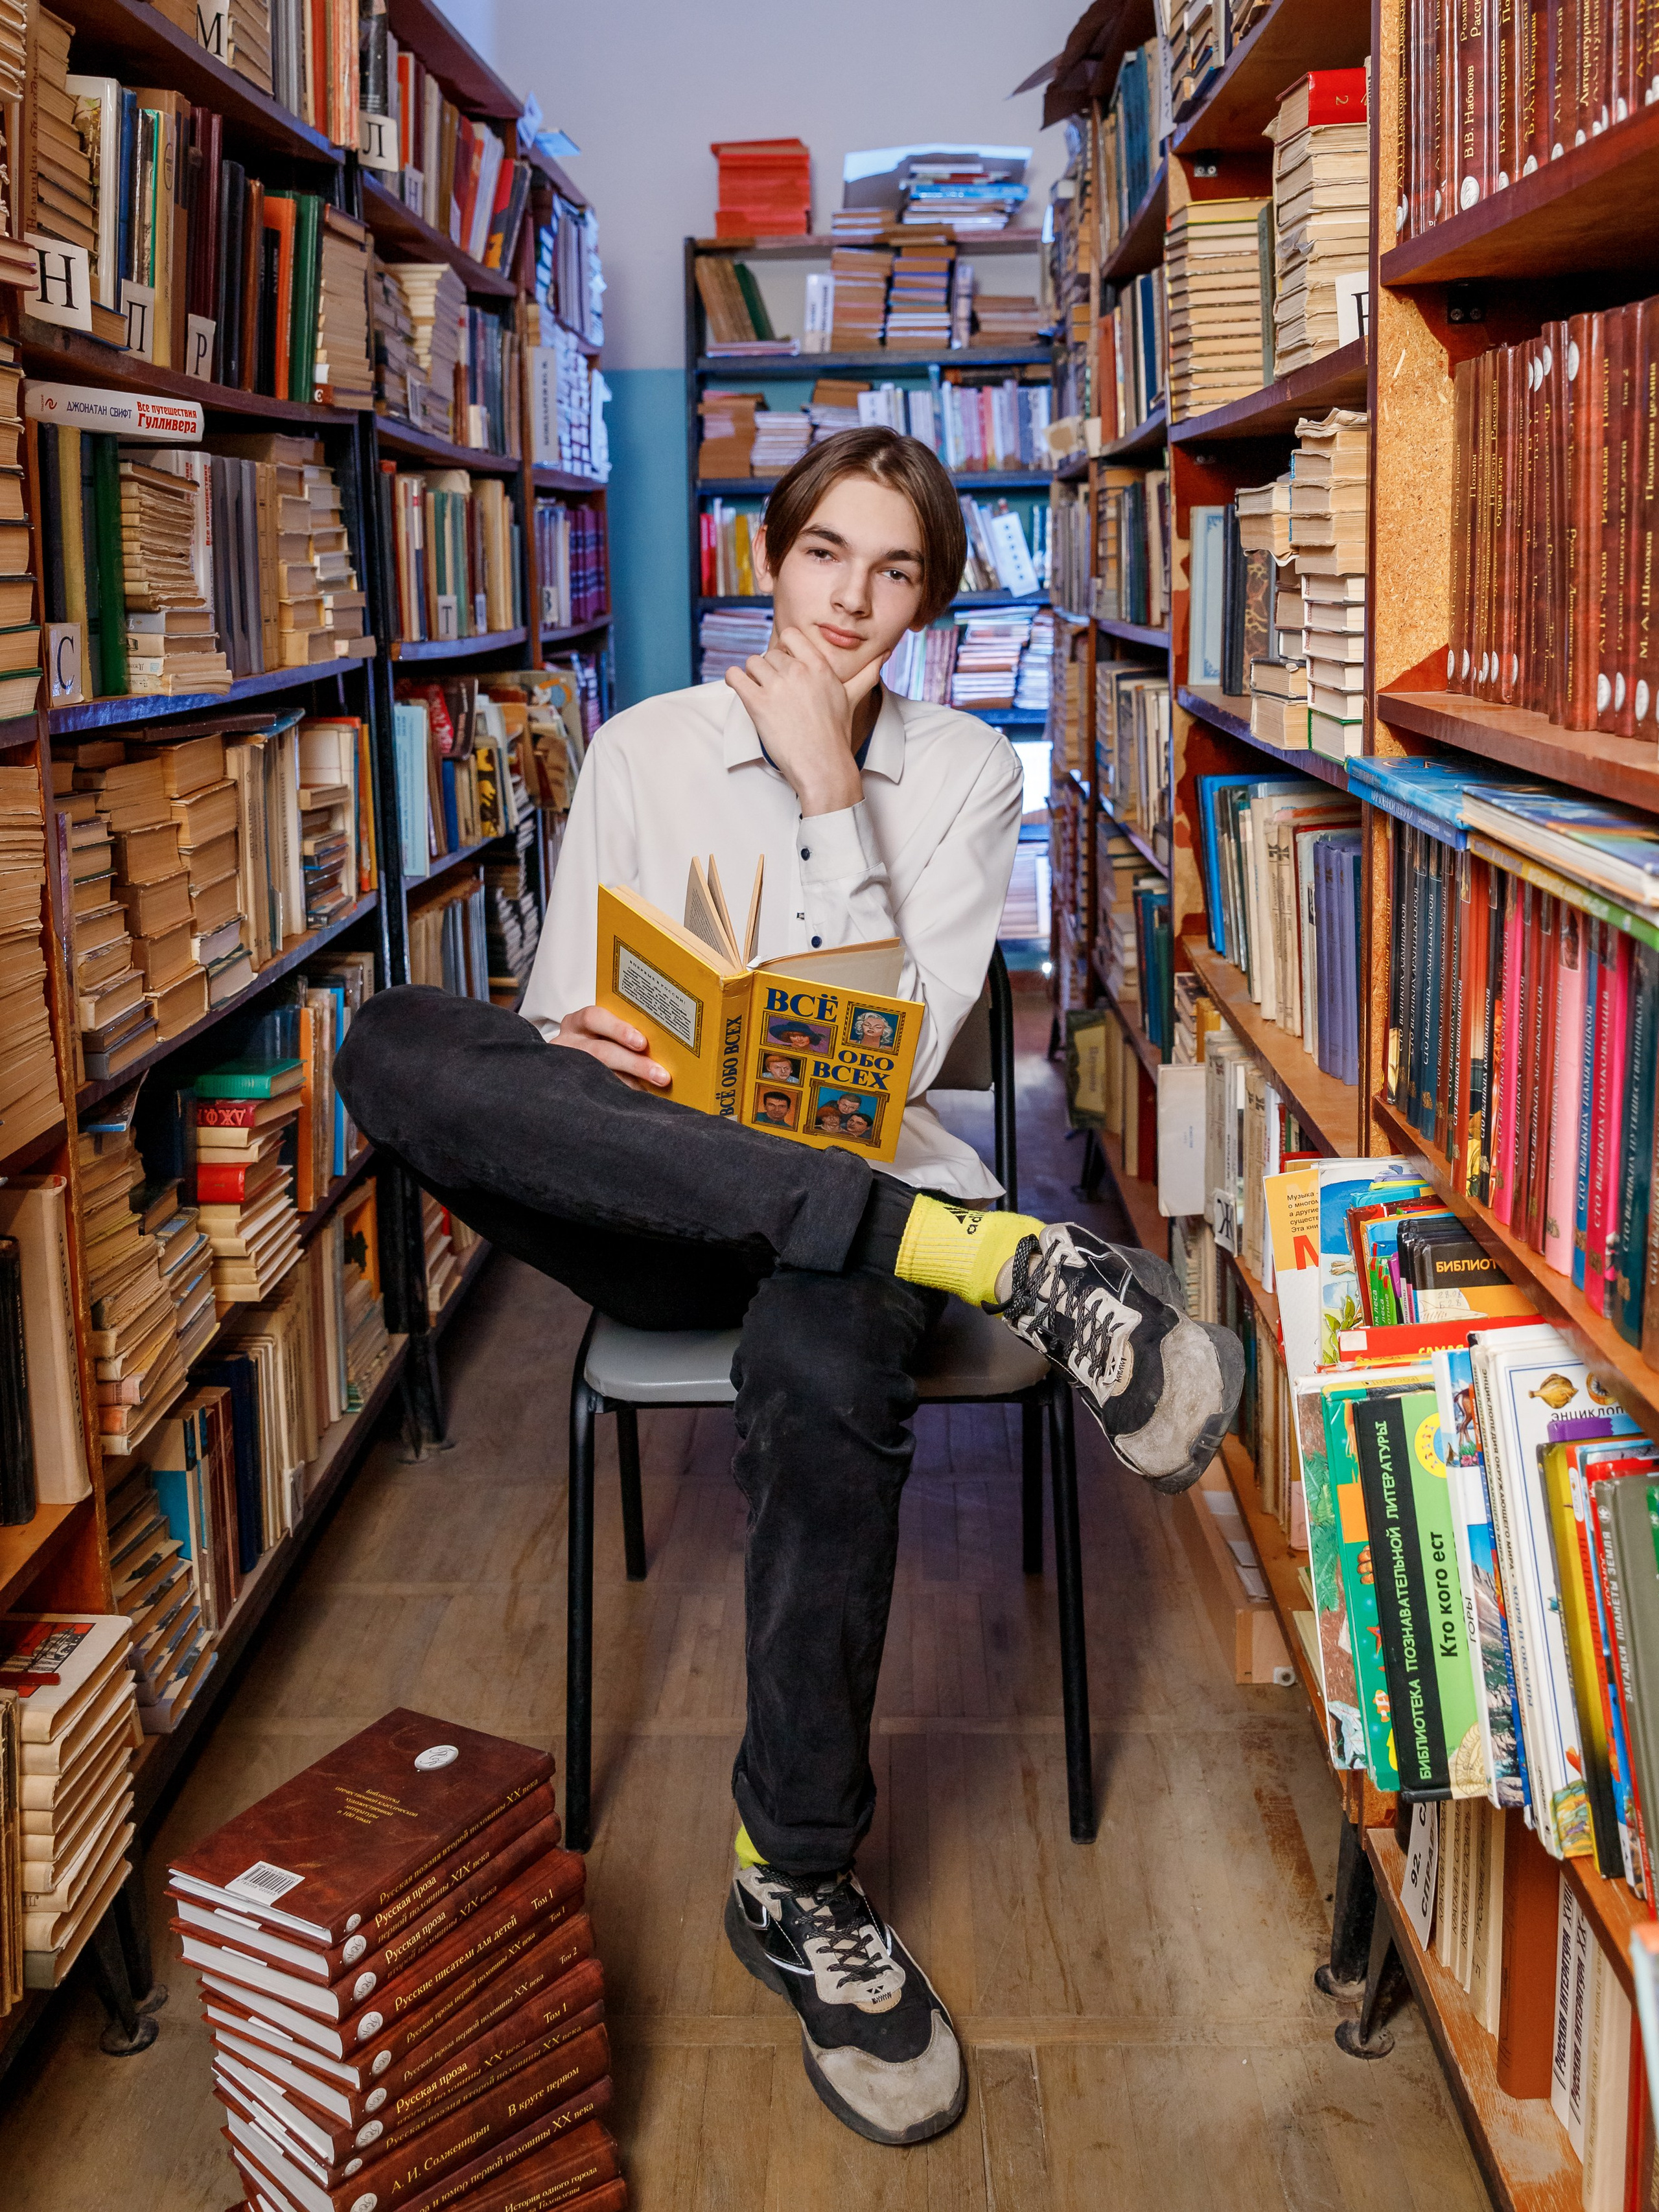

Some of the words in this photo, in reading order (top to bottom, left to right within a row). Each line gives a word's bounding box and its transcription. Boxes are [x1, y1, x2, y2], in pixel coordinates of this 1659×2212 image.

[196, 12, 224, 57] М
[1529, 12, 1538, 91] Пастернак
[1336, 95, 1349, 106] 2
[1464, 65, 1474, 125] Набоков
[1498, 40, 1507, 113] Некрасов
[364, 121, 385, 158] Л
[1464, 128, 1474, 159] В.В.
[29, 248, 79, 310] Н
[126, 301, 146, 352] П
[196, 332, 207, 375] Р
[67, 401, 108, 416] ДЖОНАТАН
[110, 408, 132, 419] СВИФТ
[137, 402, 150, 413] Все
[152, 406, 197, 419] путешествия
[1649, 363, 1658, 418] целина
[137, 413, 197, 433] Гулливера
[1645, 422, 1654, 500] Поднятая
[442, 606, 453, 635] Т
[56, 636, 75, 690] С
[1426, 894, 1434, 986] АРХИТЕКТОРОВ
[765, 987, 839, 1022] ВСЁ
[725, 1015, 743, 1055] ВСЕХ
[839, 1049, 894, 1071] ОБО
[1581, 1005, 1594, 1106] ПАМЯТНИКОВ
[1597, 991, 1610, 1113] ПОЛКОВОДЦЕВ
[721, 1056, 738, 1086] ОБО
[811, 1060, 890, 1090] ВСЕХ
[716, 1089, 736, 1116] ВСЁ
[1578, 1113, 1590, 1177] ВЕЛИКИХ
[1595, 1118, 1606, 1192] ВЕЛИКИХ
[1287, 1191, 1314, 1201] Музыка
[1577, 1181, 1586, 1211] СТО
[1593, 1195, 1603, 1228] СТО
[1623, 1157, 1636, 1220] ВЕЛИКИХ
[1217, 1198, 1233, 1239] Ж
[1621, 1222, 1631, 1252] СТО
[1373, 1421, 1400, 1520] ЛИТЕРАТУРЫ
[1472, 1364, 1489, 1449] ЭНЦИКЛОПЕДИЯ
[1496, 1534, 1505, 1563] МИРА
[1481, 1368, 1499, 1454] ЭНЦИКЛОПЕДИЯ
[1494, 1456, 1511, 1538] ОКРУЖАЮЩЕГО
[1505, 1540, 1515, 1571] МИРА
[1429, 1531, 1446, 1563] ест
[1601, 1531, 1617, 1576] ЗЕМЛЯ
[1385, 1527, 1419, 1672] ПОЗНАВАТЕЛЬНОЙ
[1432, 1567, 1452, 1616] кого
[1512, 1584, 1523, 1624] МОРЯ
[1608, 1580, 1627, 1641] ПЛАНЕТЫ
[1438, 1621, 1459, 1658] Кто
[1464, 1596, 1477, 1644] ГОРЫ
[1517, 1629, 1527, 1641] И
[1520, 1645, 1535, 1708] ОКЕАНЫ
[1617, 1644, 1634, 1702] ЗАГАДКИ
[1406, 1679, 1432, 1780] БИБЛИОТЕКА
[335, 1786, 377, 1804] отечественной
[377, 1799, 418, 1817] классической
[344, 1804, 380, 1820] литературы
[345, 1797, 393, 1816] художественной
[365, 1789, 400, 1804] Библиотека
[380, 1876, 413, 1905] Русская
[415, 1852, 441, 1878] поэзия
[443, 1829, 469, 1856] второй
[470, 1803, 506, 1836] половины
[506, 1788, 522, 1806] XX
[522, 1779, 539, 1794] века
[1462, 1814, 1472, 1878] СЛОВАРЬ
[1411, 1852, 1422, 1889] 92.
[375, 1896, 412, 1928] Русская
[412, 1876, 437, 1900] проза
[378, 1913, 408, 1943] первой
[409, 1883, 449, 1919] половины
[451, 1861, 470, 1885] XIX
[472, 1851, 490, 1869] века
[385, 1932, 421, 1964] Русская
[422, 1911, 447, 1935] проза
[395, 1978, 434, 2011] Русские
[435, 1948, 475, 1983] писатели
[476, 1937, 493, 1953] для
[494, 1914, 517, 1941] детей
[531, 1896, 548, 1910] Том
[548, 1888, 554, 1899] 1
[1558, 1927, 1572, 2009] ЛИТЕРАТУРА
[404, 2056, 434, 2081] Русская
[434, 2039, 454, 2059] проза
[456, 2018, 480, 2042] первой
[480, 1996, 513, 2023] половины
[515, 1981, 529, 1999] XX
[529, 1973, 544, 1988] века
[559, 1954, 572, 1965] Том
[572, 1946, 578, 1955] 2
[386, 2122, 426, 2149] Русская
[428, 2099, 461, 2124] поэзия
[463, 2076, 495, 2101] второй
[497, 2050, 542, 2080] половины
[542, 2034, 561, 2053] XX
[562, 2025, 581, 2041] века
[395, 2080, 438, 2114] Русская
[439, 2062, 468, 2086] проза
[508, 2104, 517, 2117] В
[518, 2090, 544, 2112] круге
[546, 2067, 579, 2092] первом
[391, 2180, 404, 2193] А.
[407, 2168, 421, 2183] И.
[424, 2123, 491, 2171] Солженицын
[442, 2180, 468, 2201] юмор
[471, 2155, 503, 2185] первой
[505, 2129, 551, 2161] половины
[551, 2112, 572, 2132] XX
[574, 2103, 594, 2119] века
[505, 2194, 541, 2212] История
[542, 2181, 570, 2198] одного
[571, 2167, 597, 2184] города
